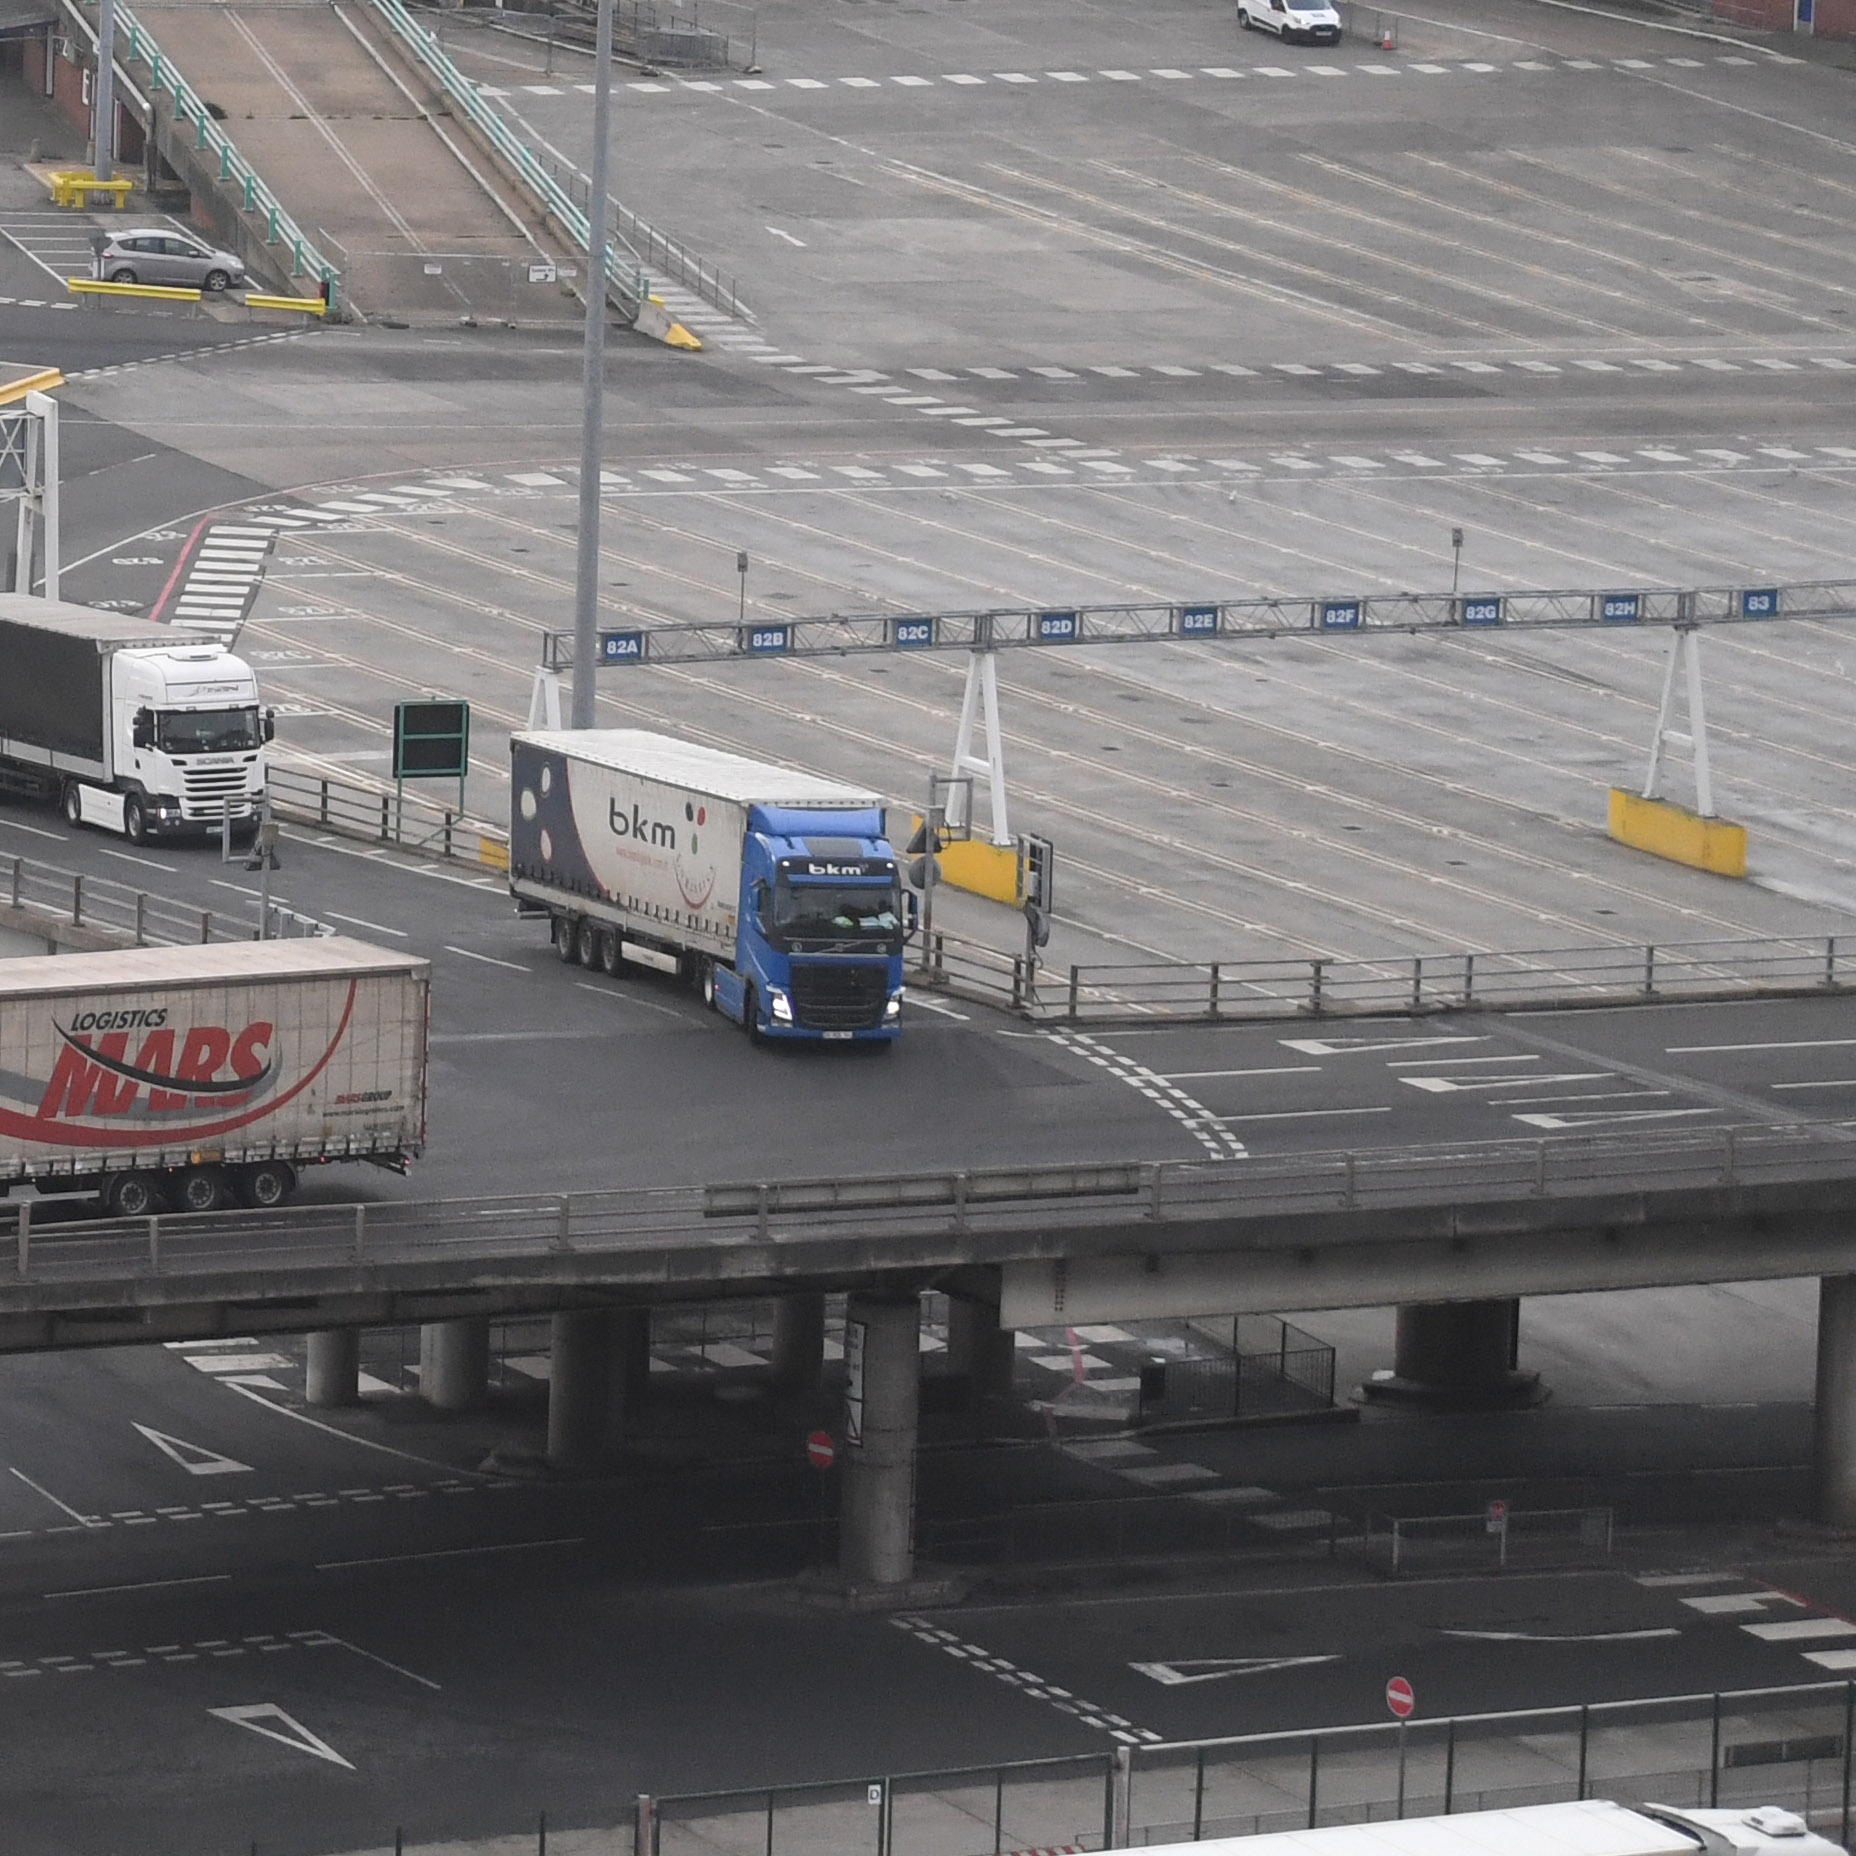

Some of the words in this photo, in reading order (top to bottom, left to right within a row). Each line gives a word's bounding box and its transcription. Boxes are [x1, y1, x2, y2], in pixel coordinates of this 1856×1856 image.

[1605, 602, 1635, 616] 82H
[1748, 596, 1770, 611] 83
[1326, 609, 1356, 623] 82F
[1466, 605, 1496, 619] 82G
[1041, 620, 1072, 634] 82D
[1184, 614, 1214, 628] 82E
[753, 632, 784, 647] 82B
[898, 626, 929, 640] 82C
[607, 640, 638, 654] 82A
[609, 797, 676, 850] bkm
[809, 863, 862, 875] bkm
[71, 1008, 168, 1031] LOGISTICS
[34, 1021, 273, 1119] MARS
[870, 1789, 880, 1801] D
